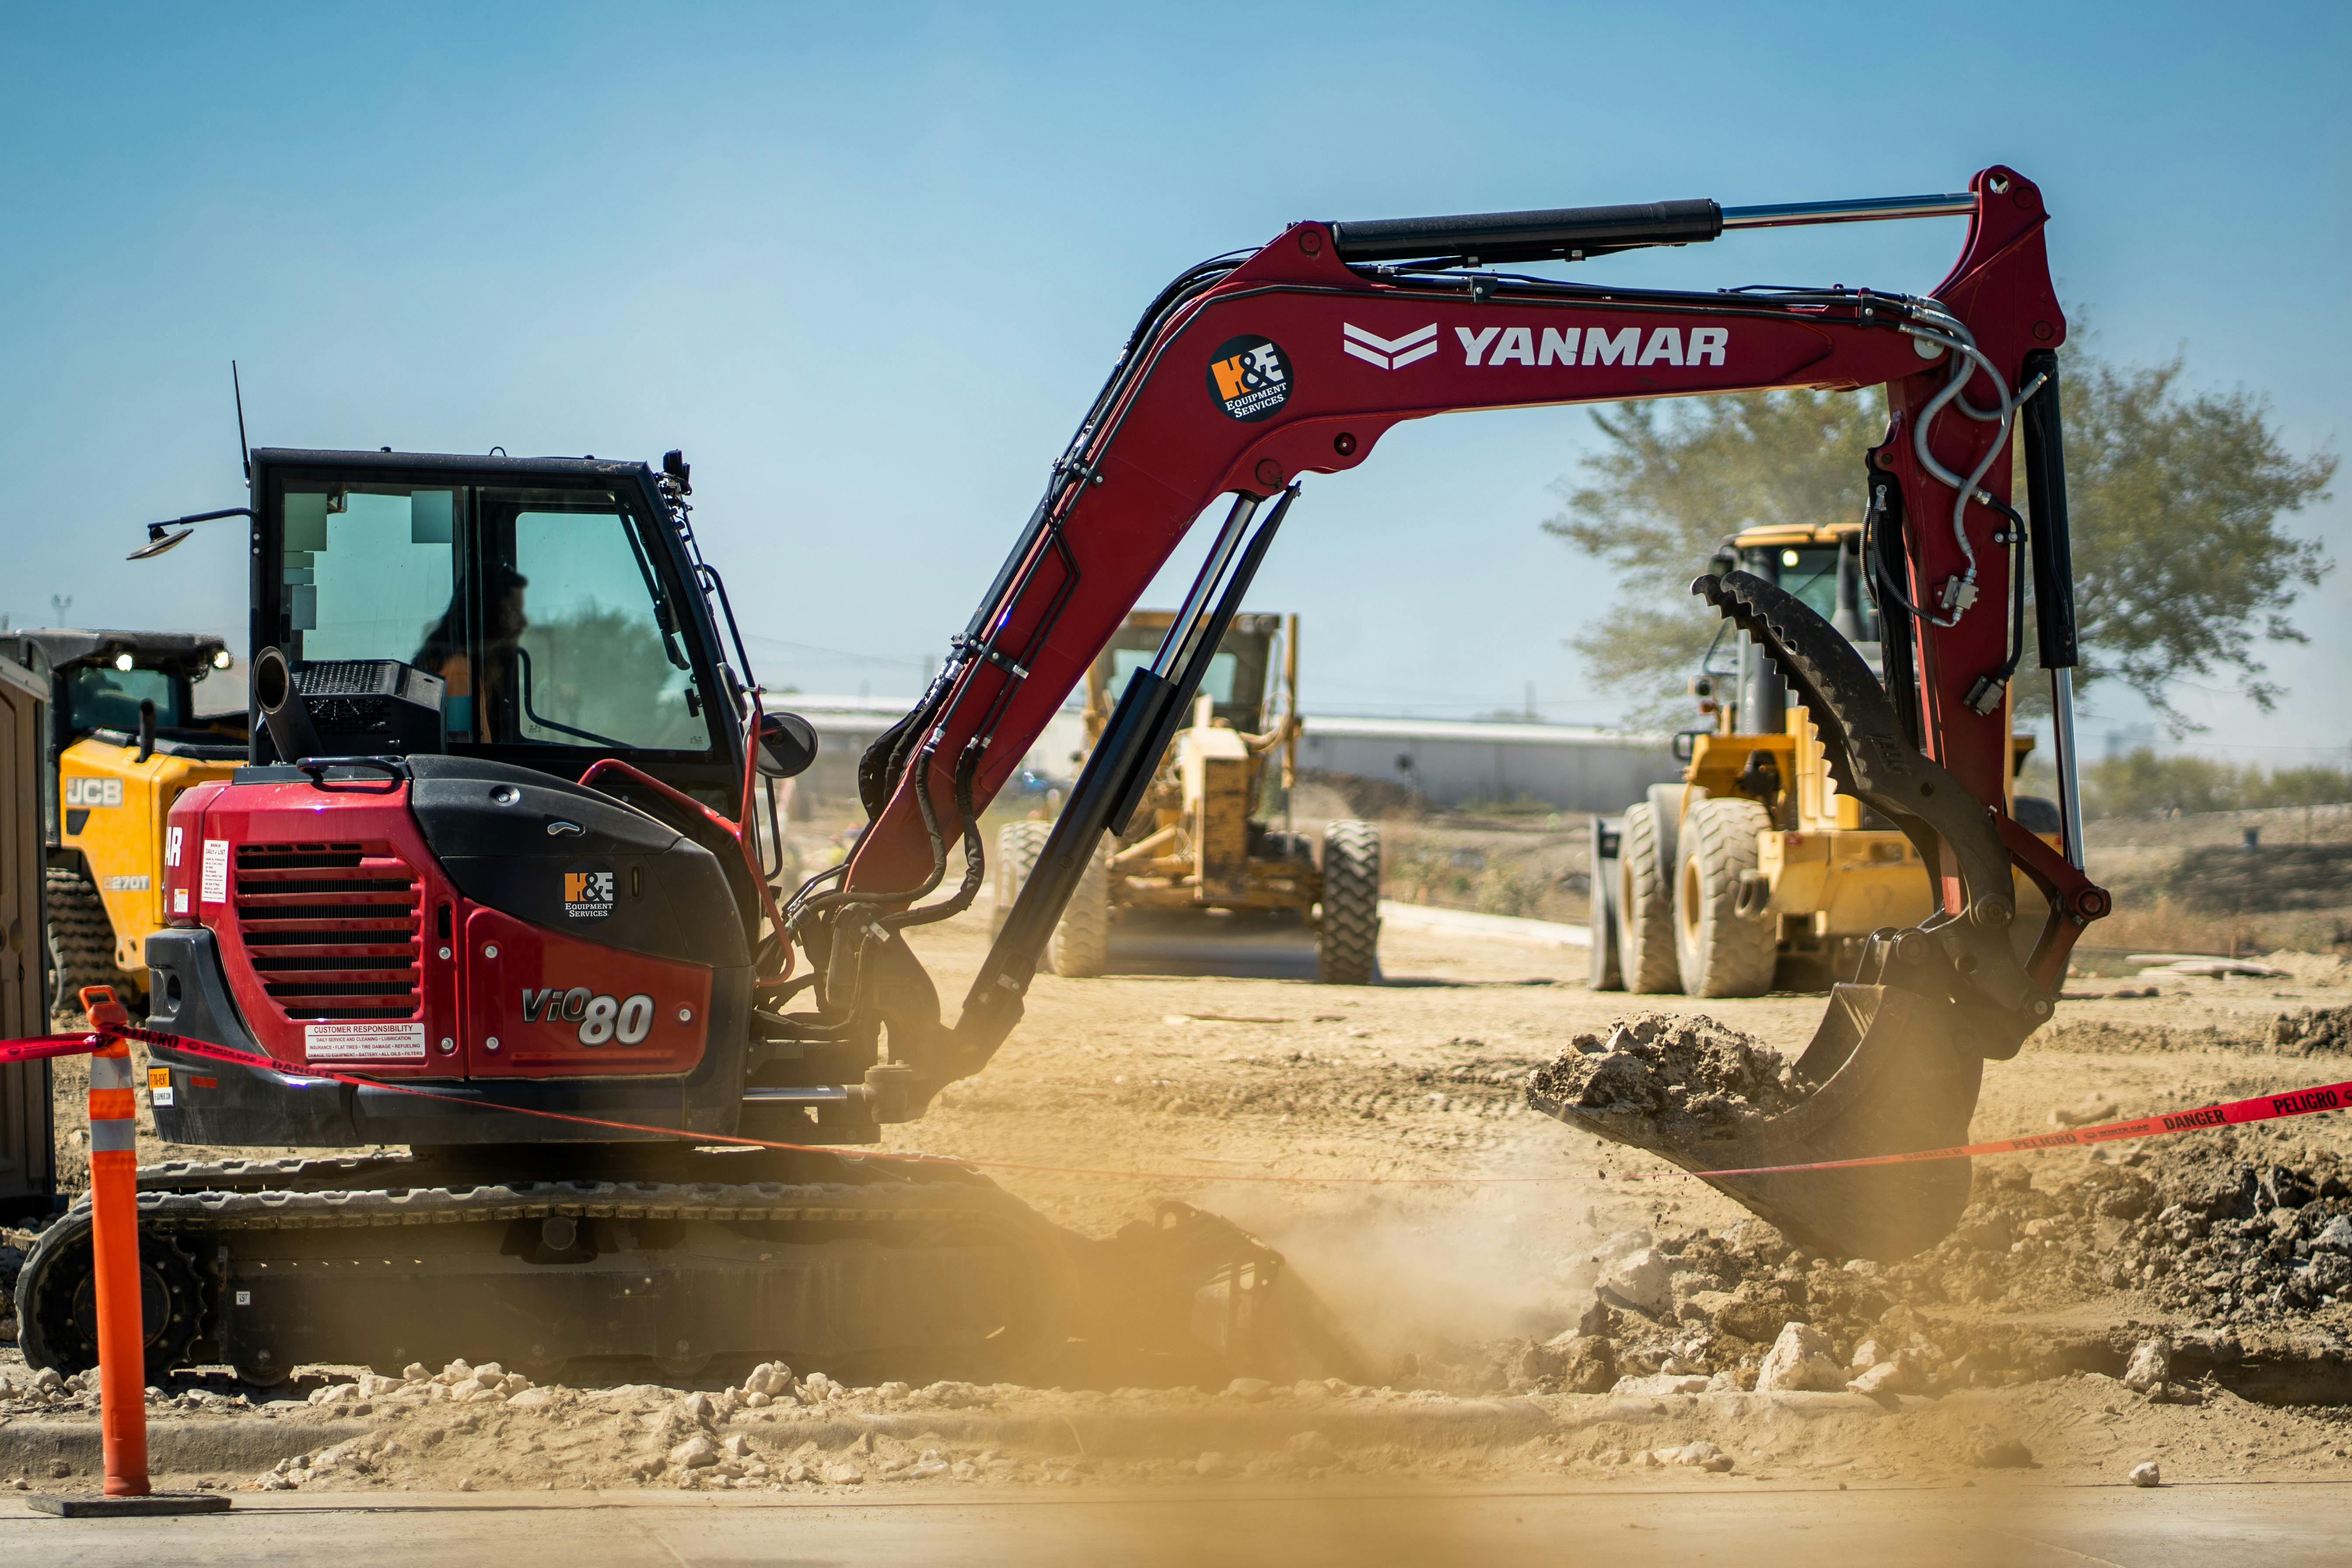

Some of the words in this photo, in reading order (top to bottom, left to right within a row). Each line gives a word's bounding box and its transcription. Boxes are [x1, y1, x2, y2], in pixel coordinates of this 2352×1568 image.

[1454, 327, 1728, 366] YANMAR
[1211, 343, 1284, 401] H&E
[67, 779, 122, 806] JCB
[112, 875, 149, 890] 270T
[565, 872, 613, 902] H&E
[272, 1060, 335, 1079] DANGER
[1902, 1148, 1964, 1160] DANGER
[2012, 1133, 2077, 1149] PELIGRO
[2163, 1109, 2227, 1130] DANGER
[2272, 1090, 2338, 1114] PELIGRO
